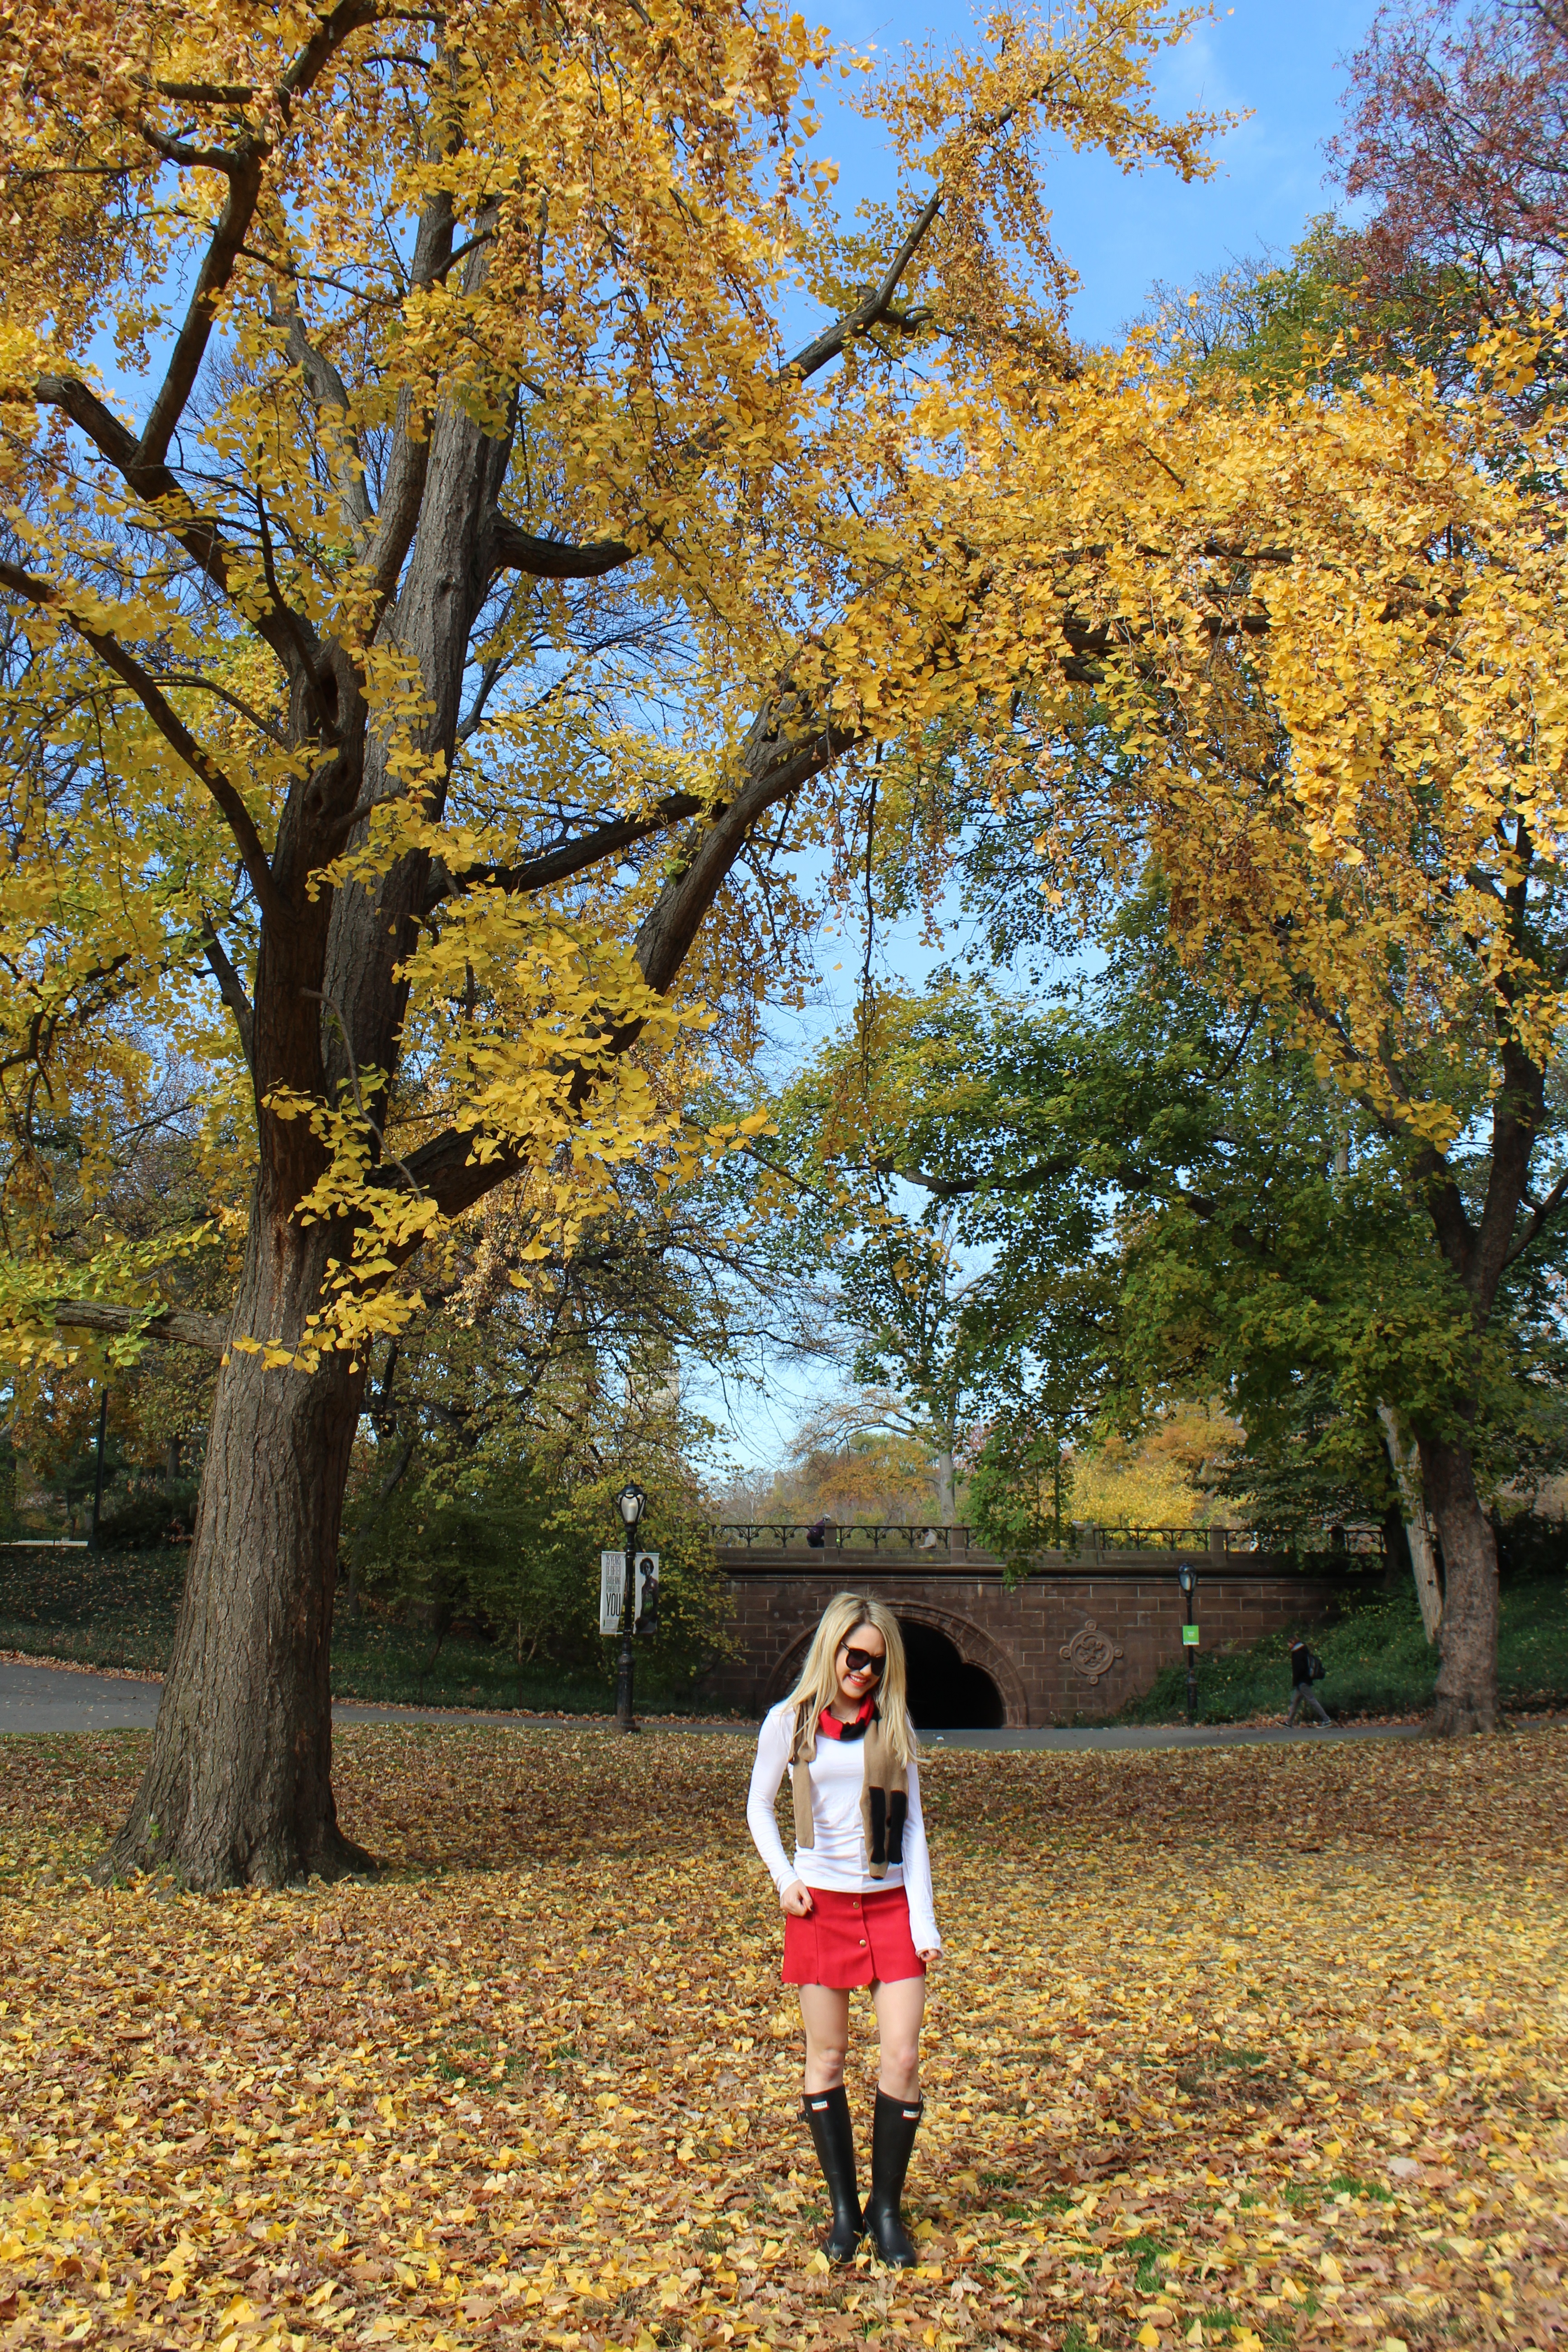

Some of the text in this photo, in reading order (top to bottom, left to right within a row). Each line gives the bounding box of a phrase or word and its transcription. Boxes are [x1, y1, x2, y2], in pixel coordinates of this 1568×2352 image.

[606, 1554, 621, 1565] 35 YEARS
[606, 1566, 621, 1576] OF GIFTED
[606, 1593, 621, 1616] YOU
